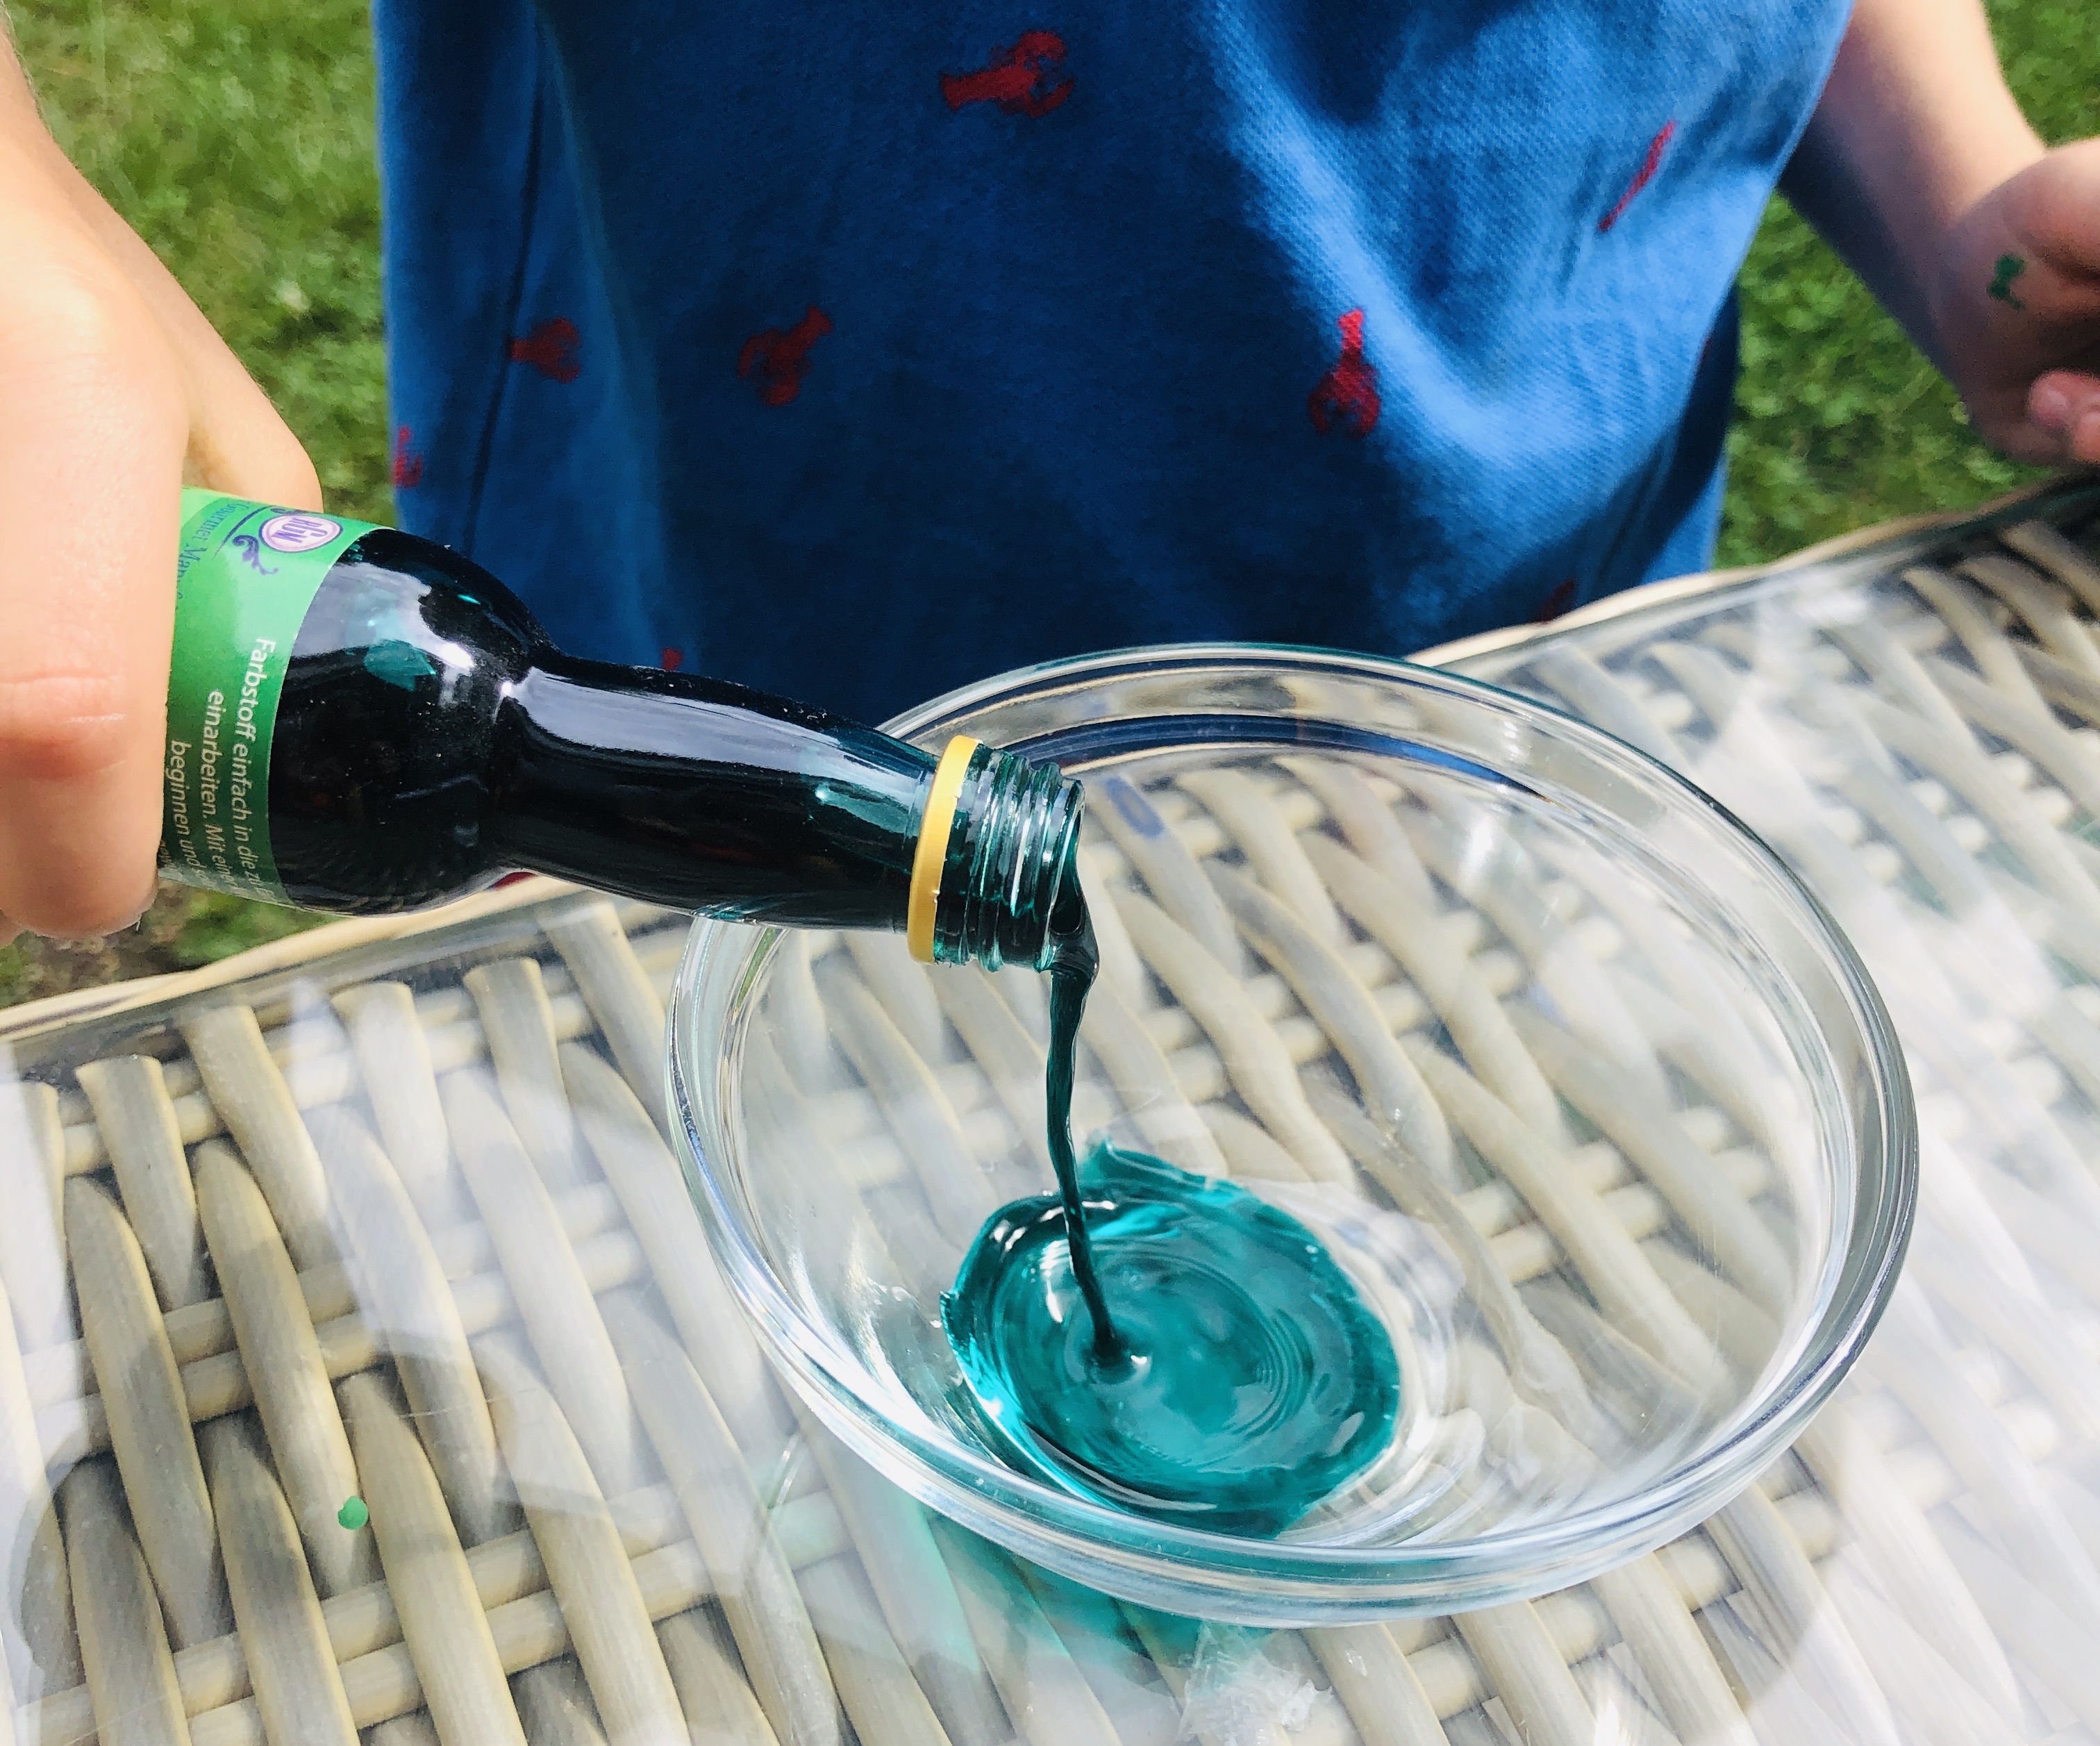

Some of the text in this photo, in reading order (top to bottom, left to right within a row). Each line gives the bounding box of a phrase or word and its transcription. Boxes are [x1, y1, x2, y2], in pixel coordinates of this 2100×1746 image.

[192, 500, 249, 541] Gourmet
[235, 638, 276, 742] Farbstoff
[201, 690, 226, 819] einarbeiten.
[231, 743, 252, 820] einfach
[165, 740, 192, 835] beginnen
[179, 839, 207, 869] und
[233, 825, 253, 842] in
[204, 824, 226, 854] Mit
[238, 845, 260, 869] die
